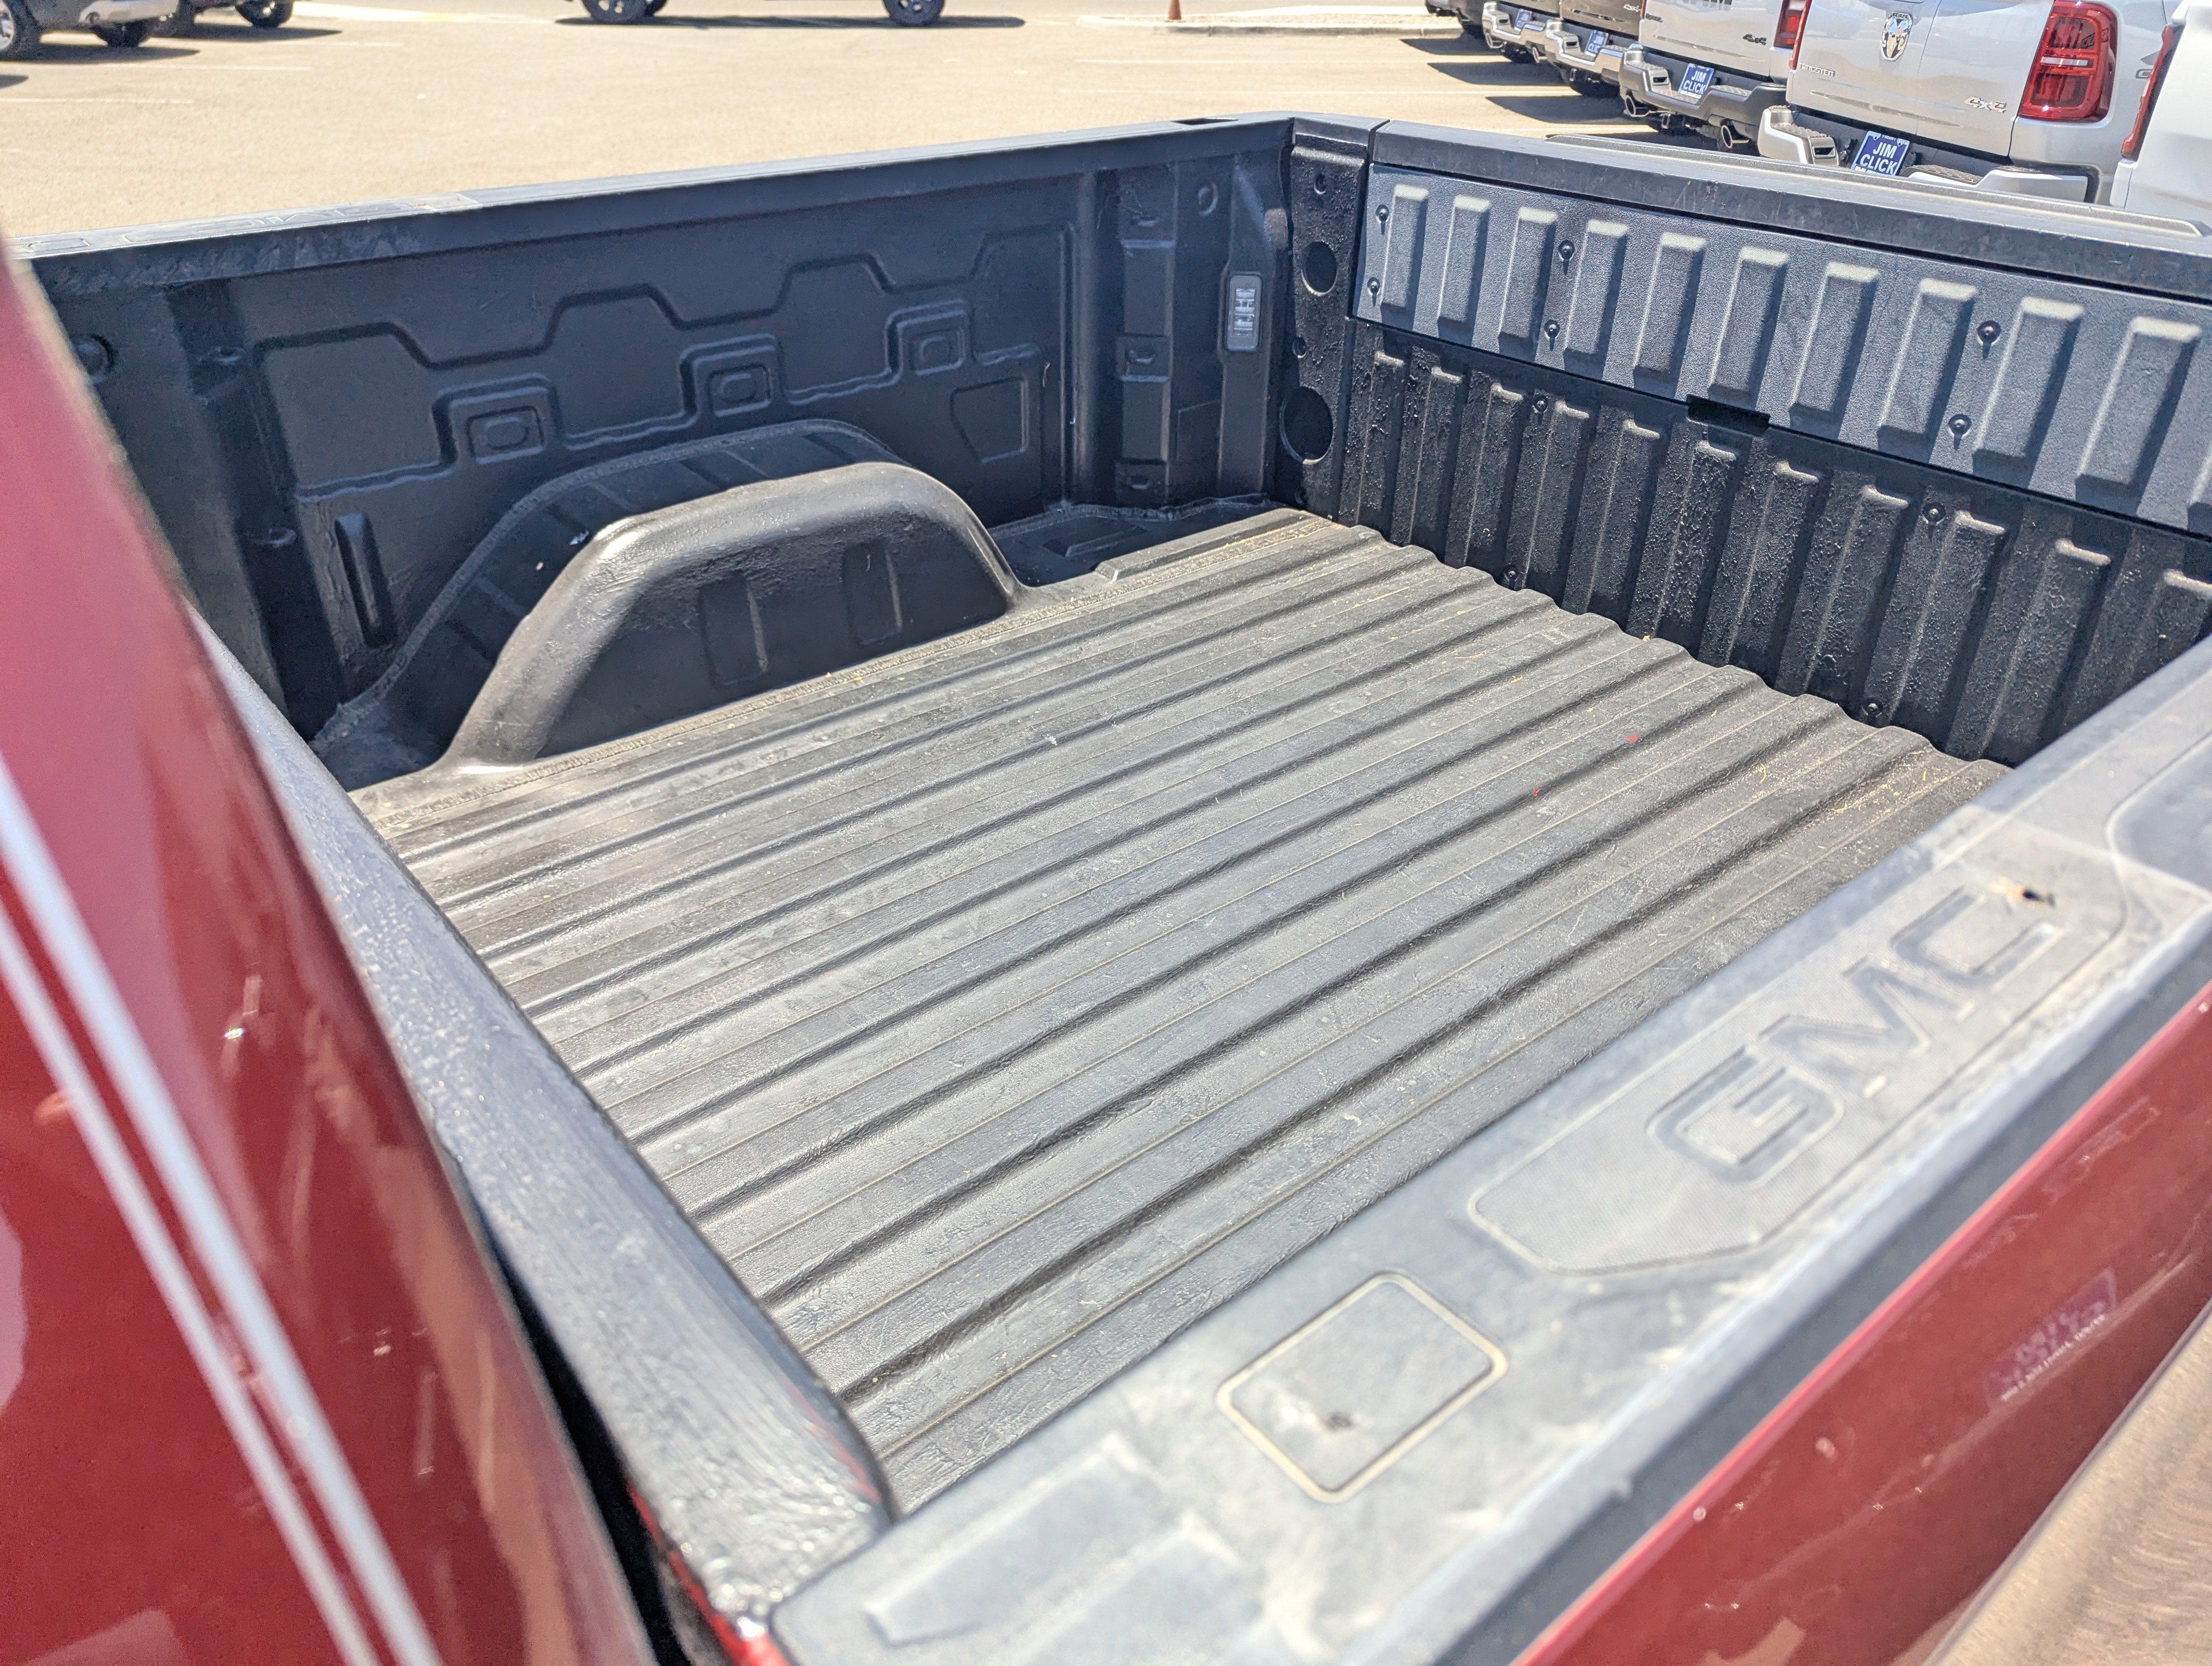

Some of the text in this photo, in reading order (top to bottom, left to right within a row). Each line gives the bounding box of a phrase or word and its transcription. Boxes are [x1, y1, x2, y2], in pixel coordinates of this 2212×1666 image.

[1691, 71, 1707, 83] JIM
[1683, 80, 1707, 95] CLICK
[1873, 142, 1898, 159] JIM
[1860, 153, 1898, 175] CLICK
[1646, 881, 2065, 1189] GMC
